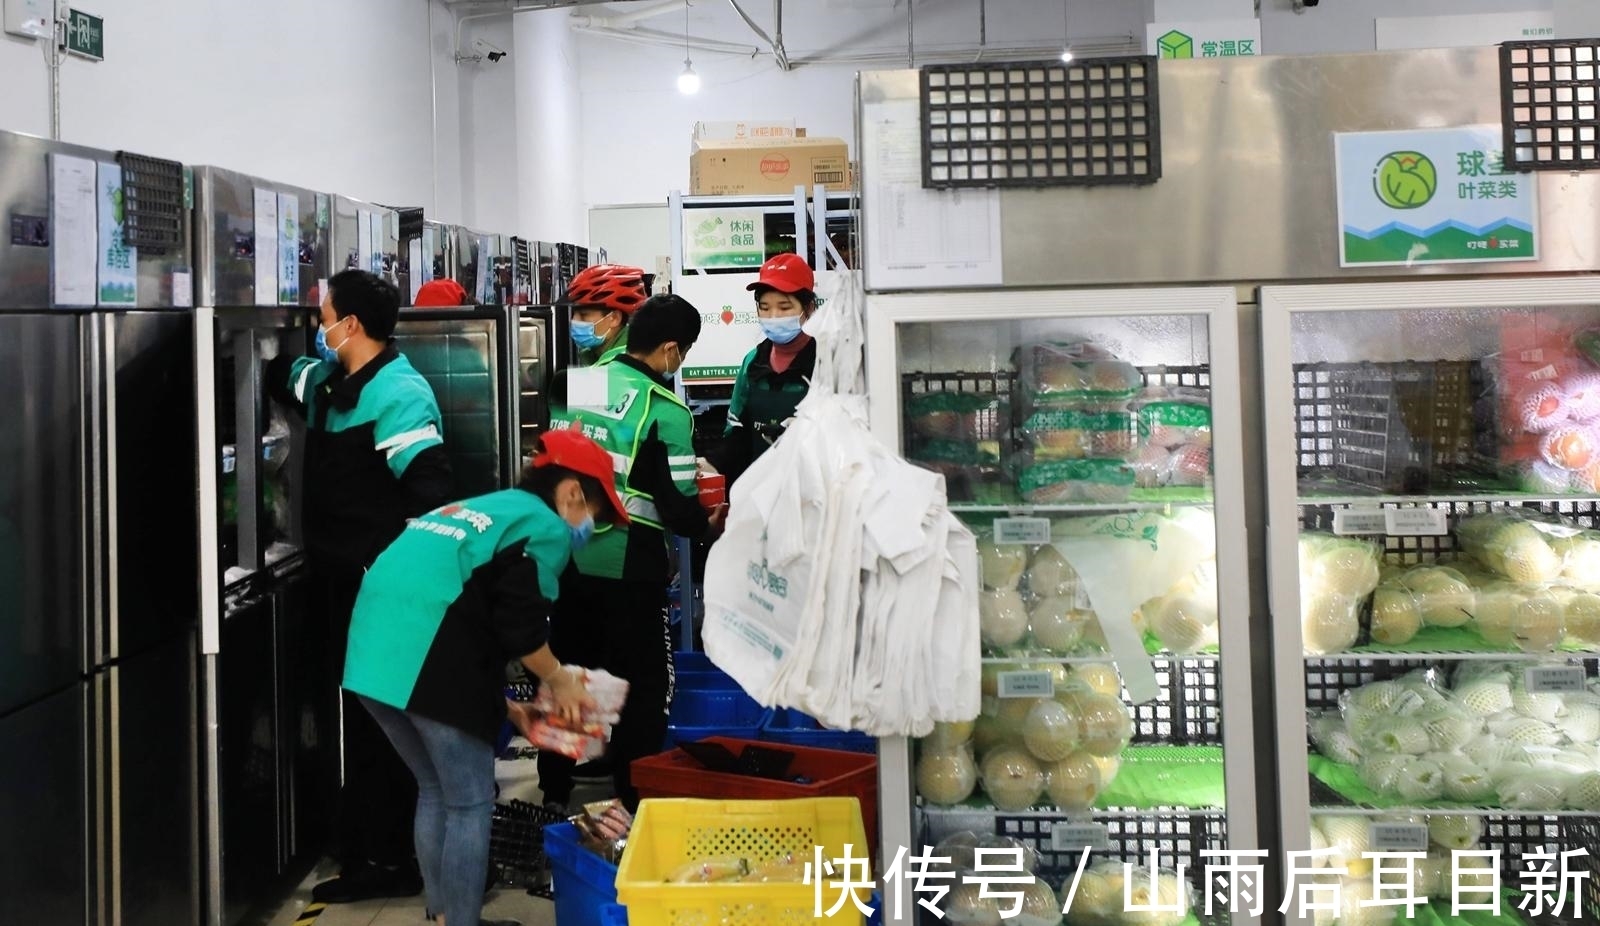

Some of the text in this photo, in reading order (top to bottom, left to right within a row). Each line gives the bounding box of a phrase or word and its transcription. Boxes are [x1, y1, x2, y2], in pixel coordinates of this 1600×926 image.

[1201, 40, 1255, 57] 常温区
[1458, 181, 1517, 200] 叶菜类
[730, 220, 754, 232] 休闲
[731, 234, 754, 246] 食品
